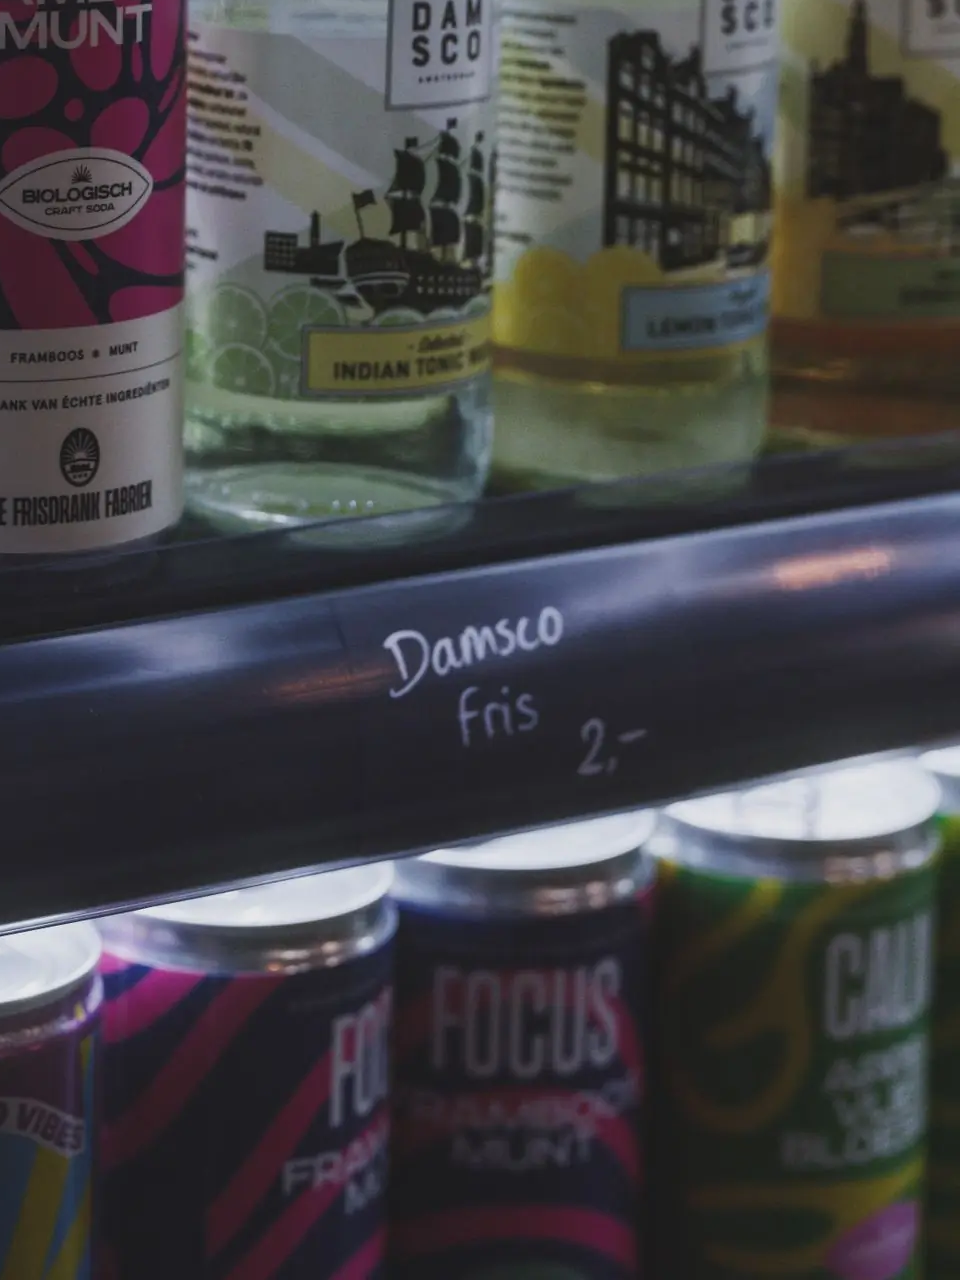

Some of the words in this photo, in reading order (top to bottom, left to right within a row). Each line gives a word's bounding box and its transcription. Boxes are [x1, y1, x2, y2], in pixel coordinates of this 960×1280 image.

[411, 30, 482, 68] SCO
[22, 182, 133, 204] BIOLOGISCH
[44, 205, 83, 217] CRAFT
[86, 202, 116, 215] SODA
[10, 348, 85, 364] FRAMBOOS
[108, 341, 139, 357] MUNT
[333, 360, 411, 381] INDIAN
[31, 396, 58, 410] VAN
[61, 393, 103, 409] ÉCHTE
[106, 377, 171, 405] INGREDIËNTEN
[11, 491, 101, 526] FRISDRANK
[105, 480, 153, 516] FABRIEK
[383, 605, 565, 698] Damsco
[431, 953, 623, 1080] FOCUS
[15, 1102, 86, 1151] VIBES
